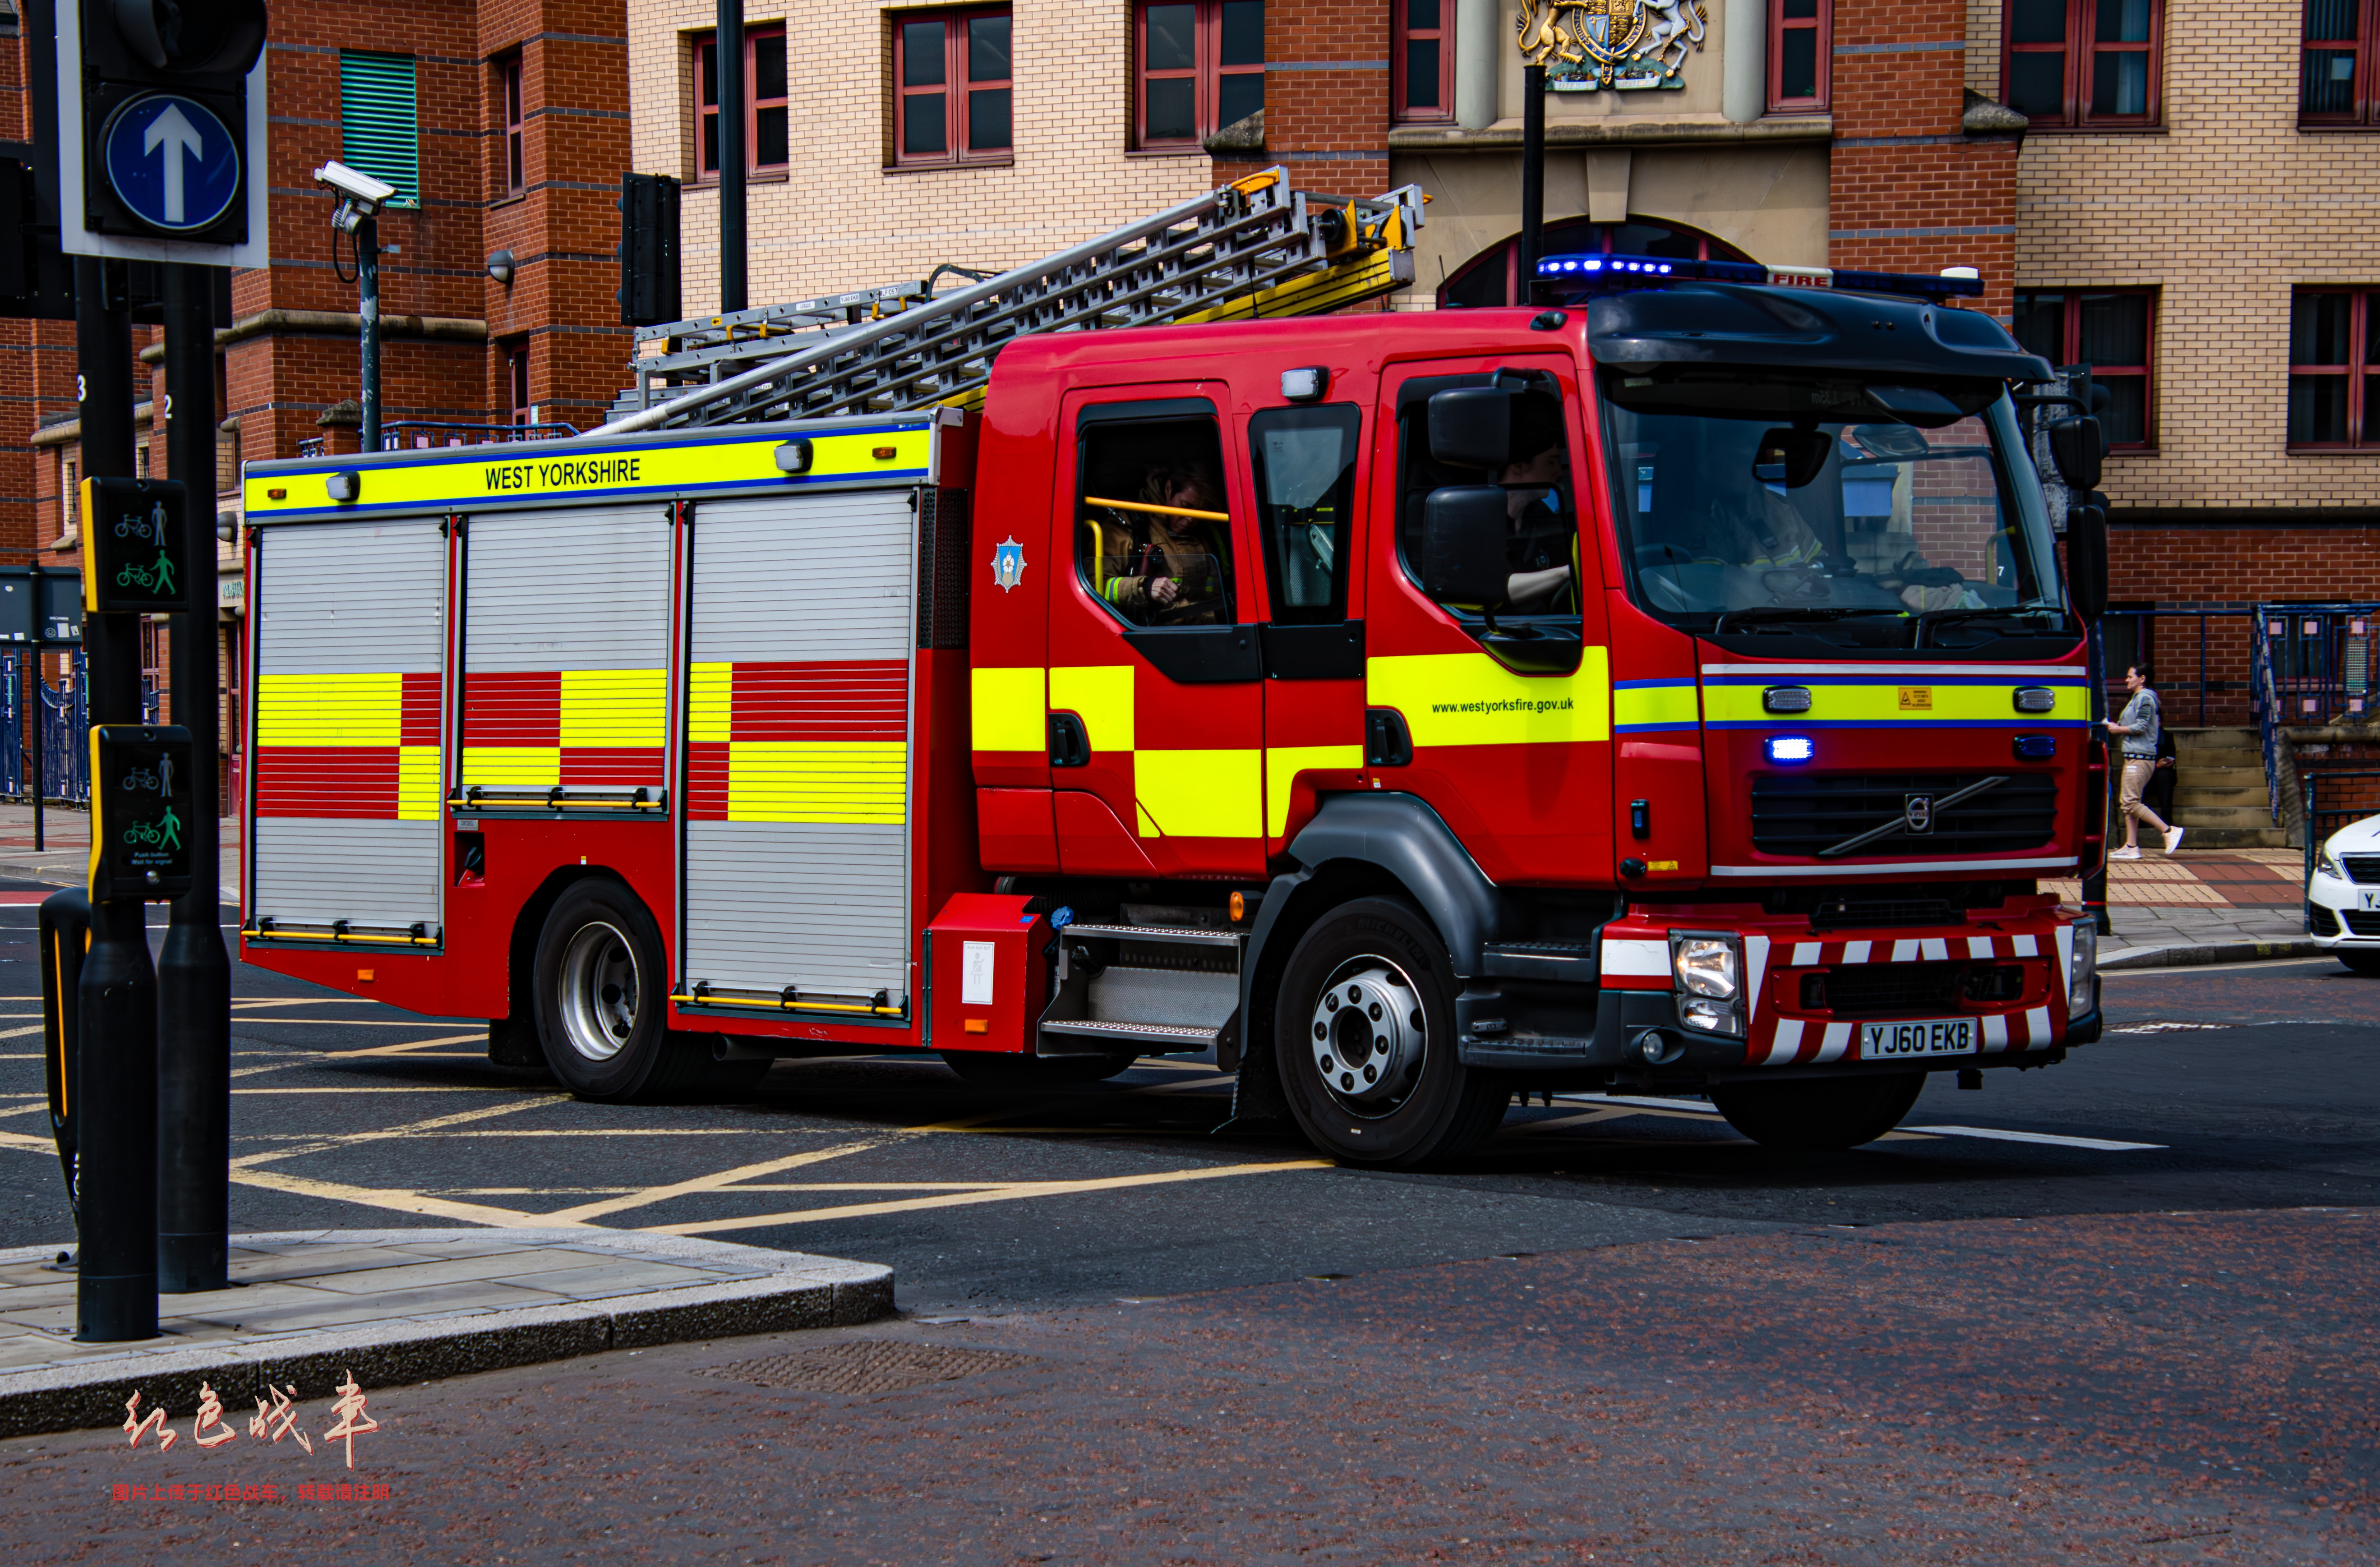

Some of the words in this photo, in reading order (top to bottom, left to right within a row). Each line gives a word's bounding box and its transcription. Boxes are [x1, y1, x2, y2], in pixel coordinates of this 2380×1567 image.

[1774, 274, 1828, 286] FIRE
[78, 374, 87, 402] 3
[165, 394, 172, 419] 2
[486, 465, 533, 490] WEST
[540, 458, 640, 486] YORKSHIRE
[1998, 566, 2004, 576] 7
[1432, 697, 1574, 714] www.westyorksfire.gov.uk
[1357, 917, 1430, 967] MICHELIN
[1871, 1025, 1925, 1054] YJ60
[1931, 1023, 1969, 1051] EKB
